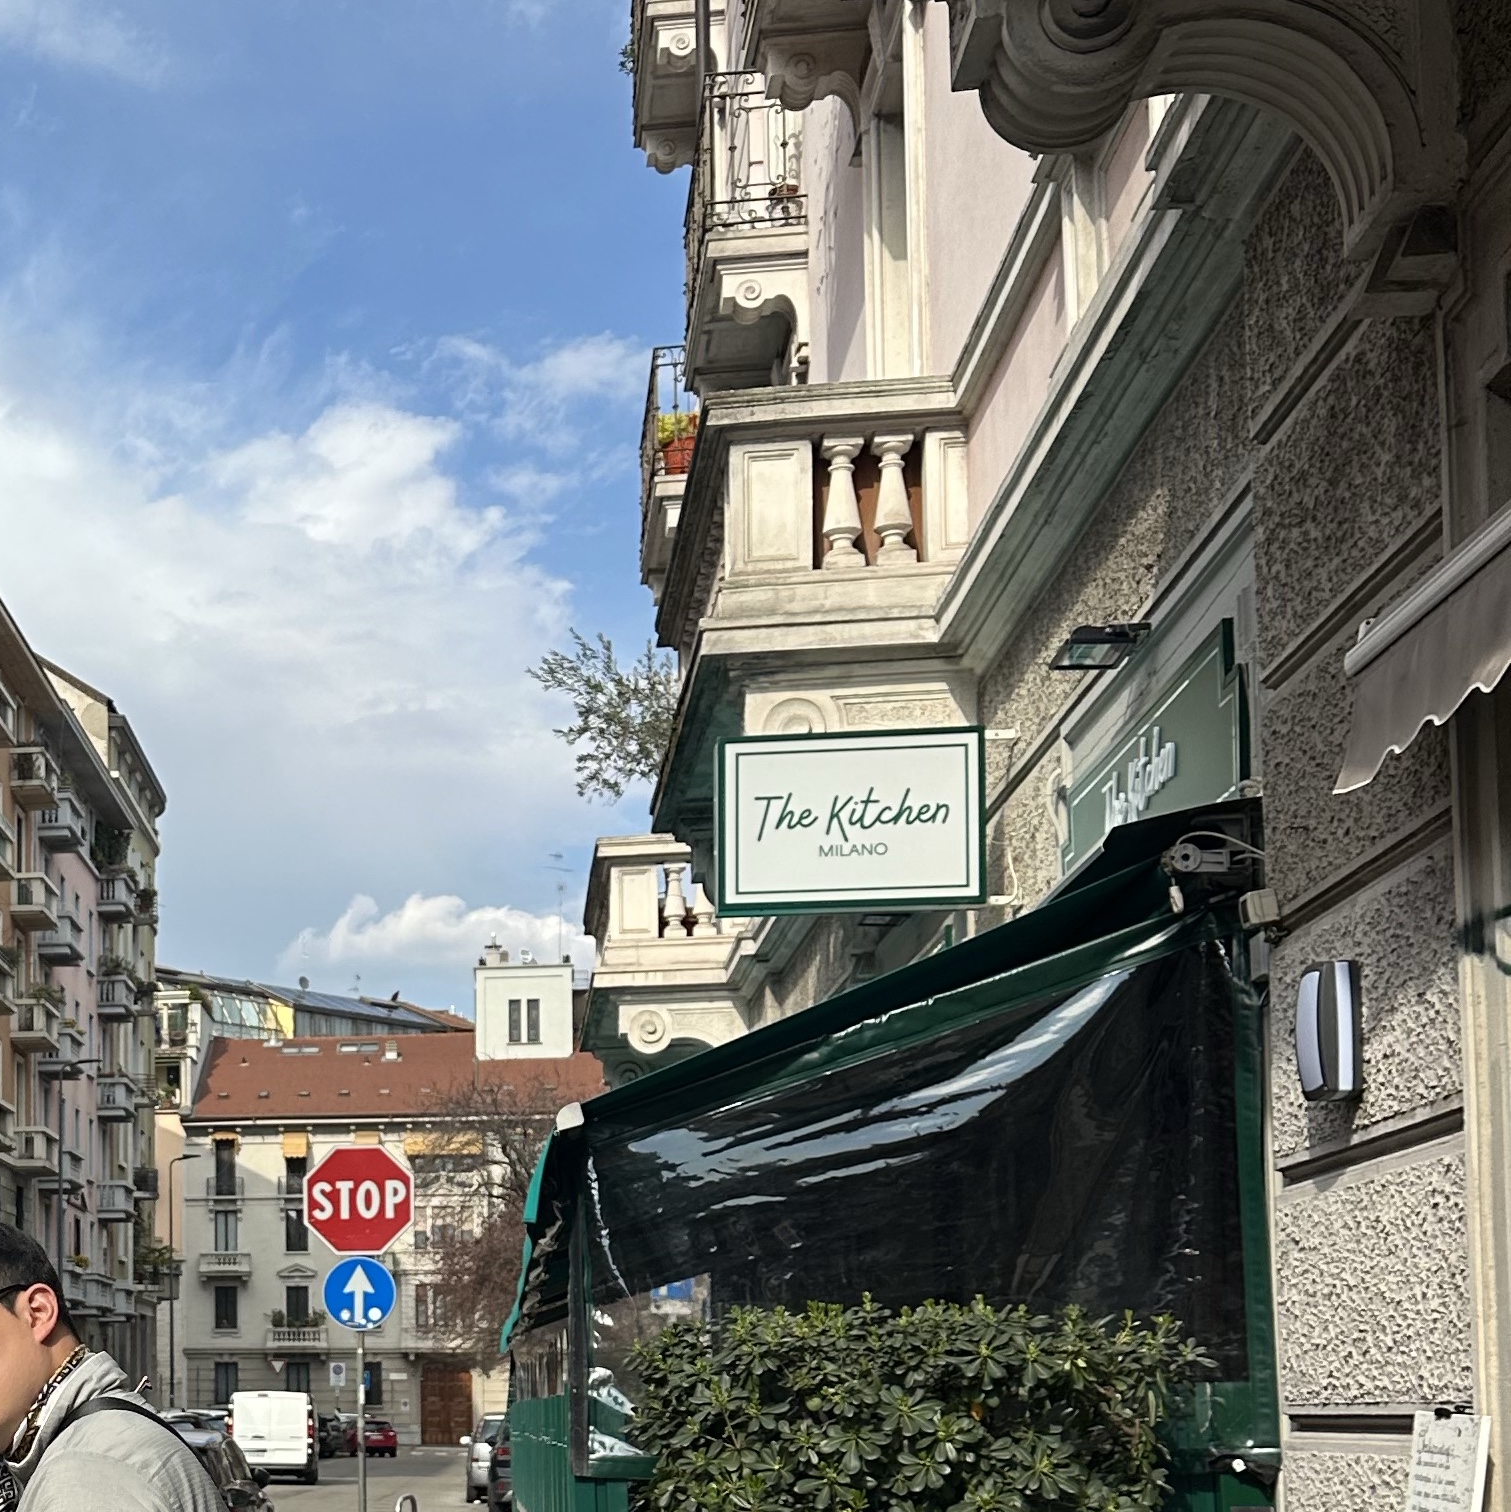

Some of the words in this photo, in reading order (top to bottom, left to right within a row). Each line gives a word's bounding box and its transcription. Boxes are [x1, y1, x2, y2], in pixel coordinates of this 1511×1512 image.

[754, 792, 819, 842] The
[825, 786, 950, 842] Kitchen
[818, 842, 889, 857] MILANO
[311, 1179, 407, 1221] STOP
